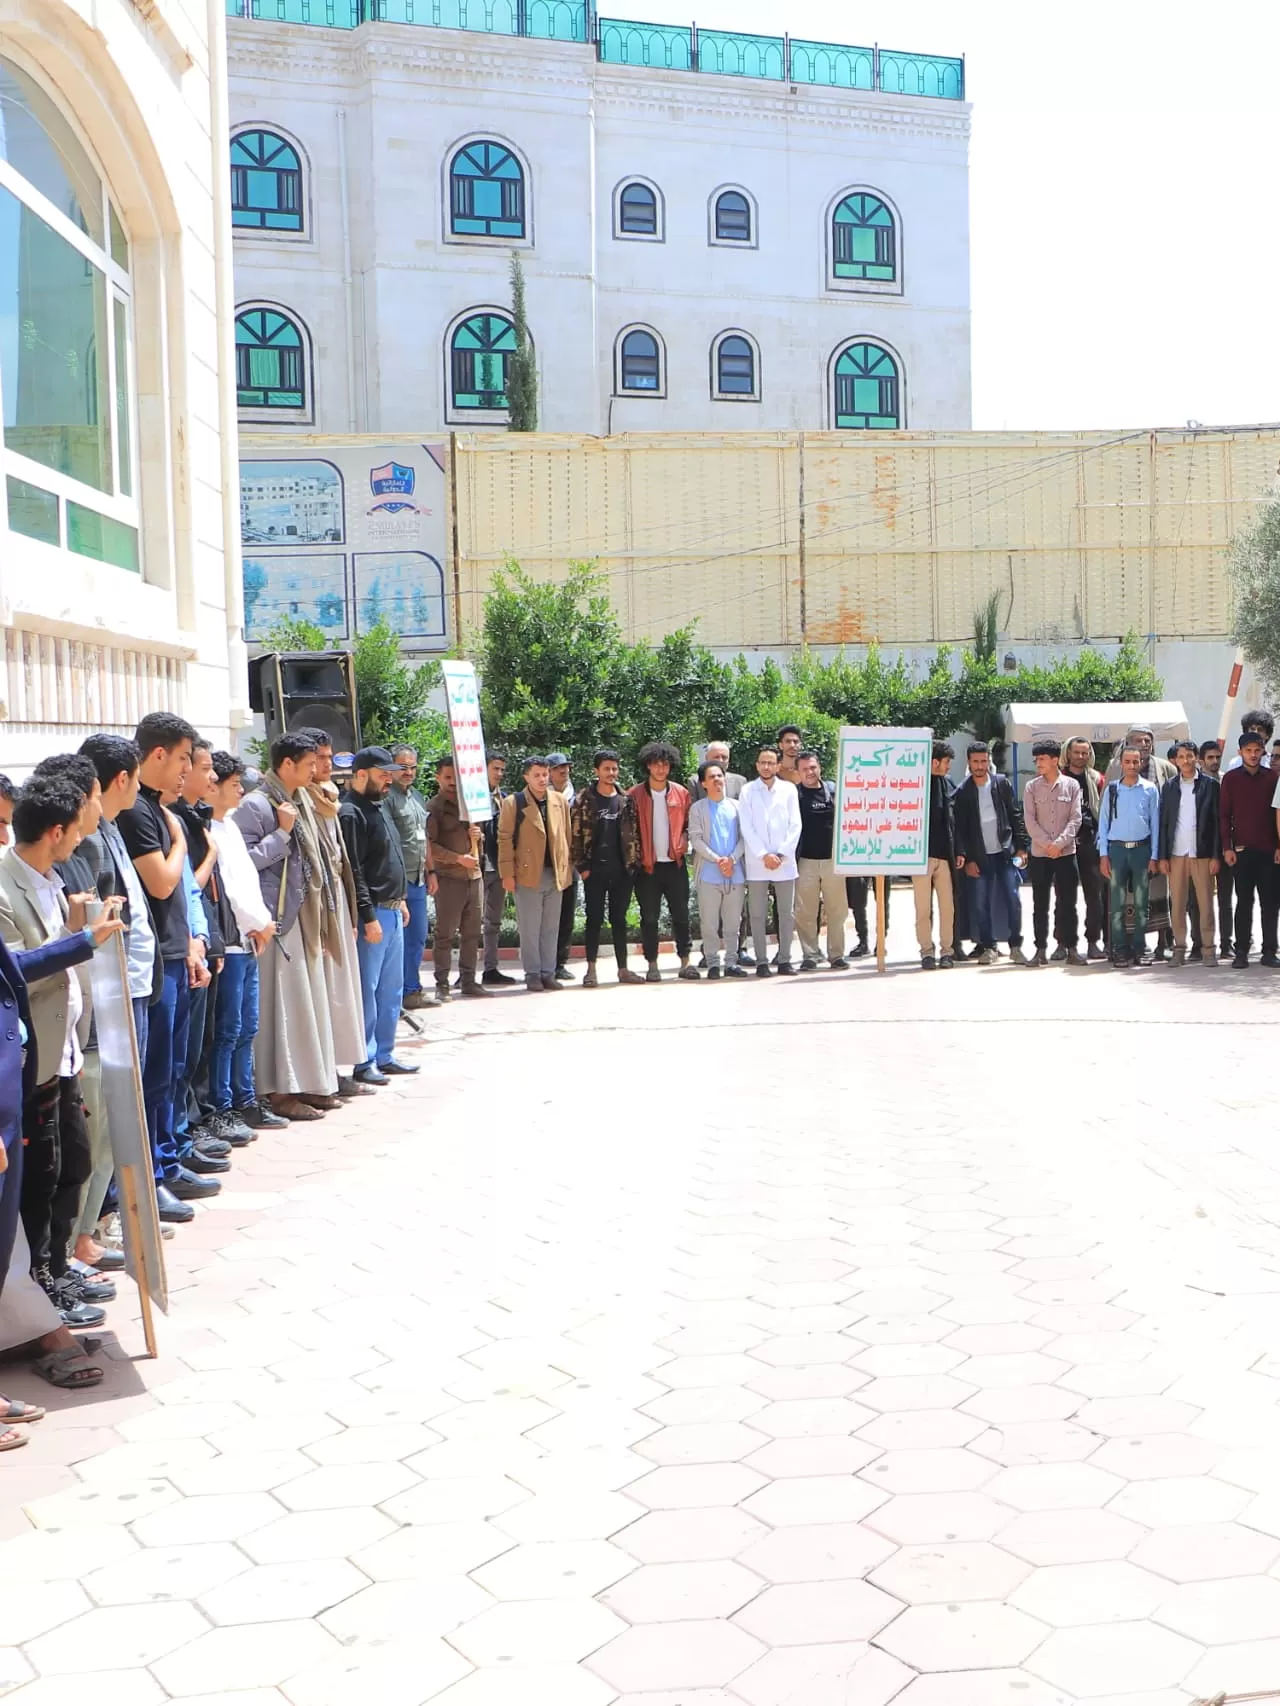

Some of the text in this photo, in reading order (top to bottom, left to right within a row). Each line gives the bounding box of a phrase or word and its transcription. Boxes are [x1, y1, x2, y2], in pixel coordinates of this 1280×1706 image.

[846, 744, 925, 772] الله أكبر
[844, 772, 924, 791] الموت لأمريكا
[843, 796, 887, 814] لإسرائيل
[888, 798, 923, 813] الموت
[842, 817, 923, 834] اللعنة على اليهود
[841, 836, 921, 861] النصر للإسلام
